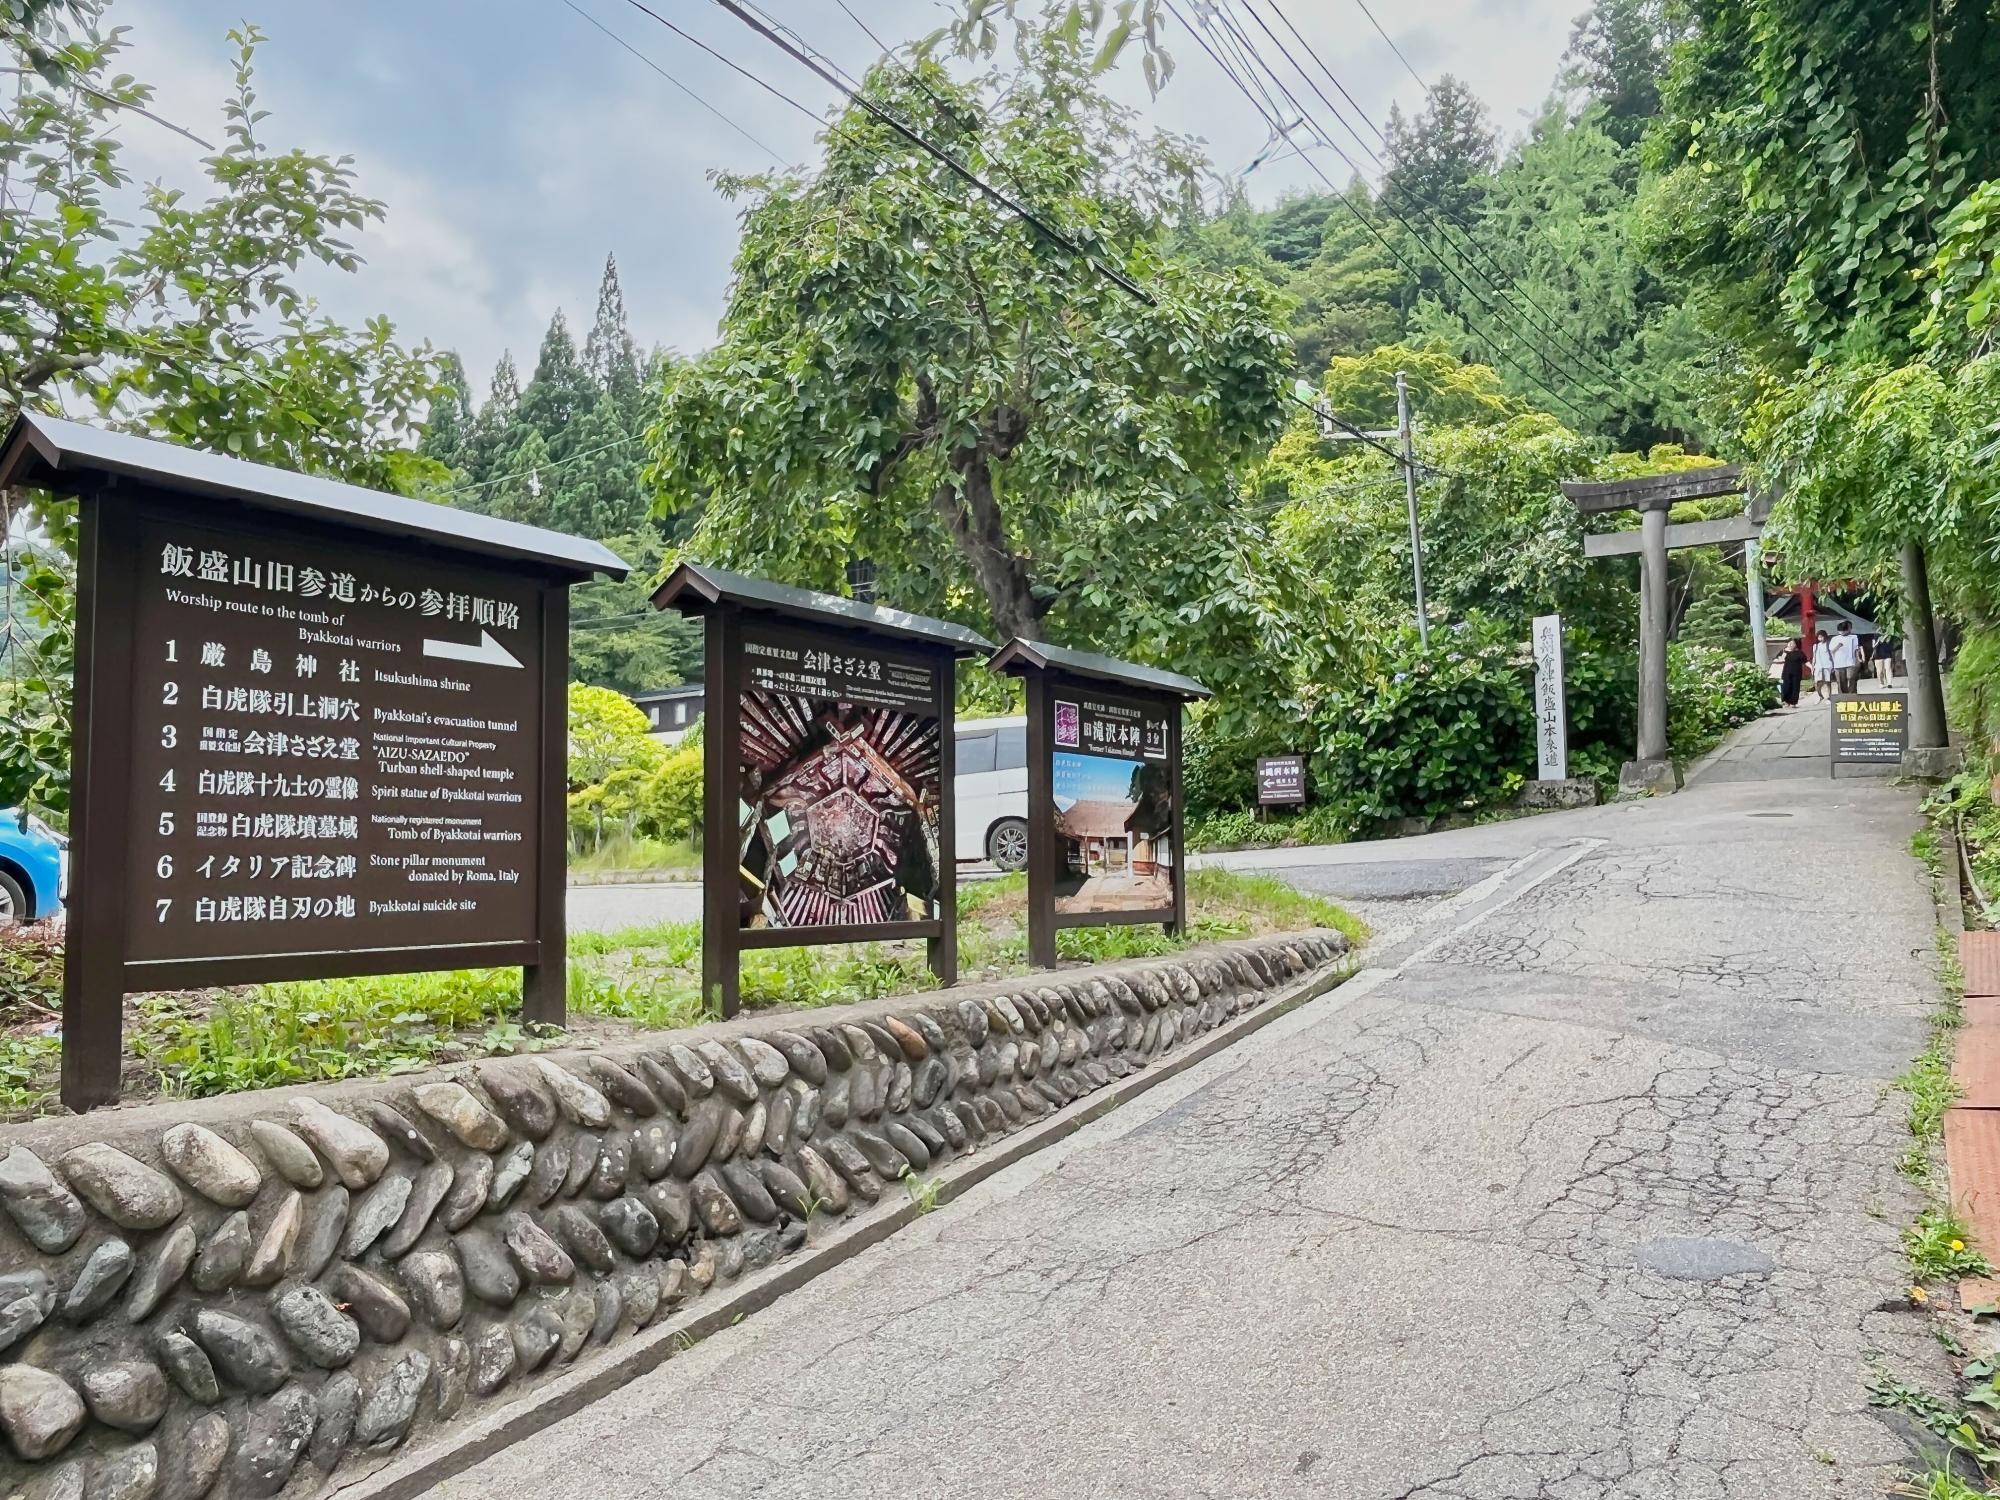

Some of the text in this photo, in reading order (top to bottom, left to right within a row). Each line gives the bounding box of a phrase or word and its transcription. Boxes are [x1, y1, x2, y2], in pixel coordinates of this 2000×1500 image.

[161, 543, 519, 629] 飯盛山旧参道からの参拝順路
[166, 588, 345, 626] Worship route to the tomb of
[299, 628, 401, 652] Byakkotai warriors
[165, 639, 360, 682] 1 厳島神社
[804, 649, 881, 680] 会津さざえ堂
[374, 668, 471, 692] Itsukushima shrine
[163, 682, 360, 721] 2 白虎隊引上洞穴
[374, 707, 517, 732] Byakkotai's evacuation tunnel
[161, 724, 177, 749] 3
[243, 731, 360, 760] 会津さざえ堂
[373, 732, 496, 751] National Important Cultural Property
[378, 760, 514, 782] Turban shell-shaped temple
[160, 769, 359, 800] 4 白虎隊十九士の霊像
[372, 785, 522, 803] Spirit statue of Byakkotai warriors
[159, 812, 175, 836] 5
[232, 813, 359, 839] 白虎隊墳墓域
[371, 814, 482, 826] Nationally registered monument
[388, 828, 522, 843] Tomb of Byakkotai warriors
[157, 854, 357, 879] 6 イタリア記念碑
[370, 854, 486, 869] Stone pillar monument
[408, 869, 520, 885] donated by Roma, Italy
[156, 895, 356, 923] 7 白虎隊自刃の地
[369, 899, 477, 916] Byakkotai suicide site
